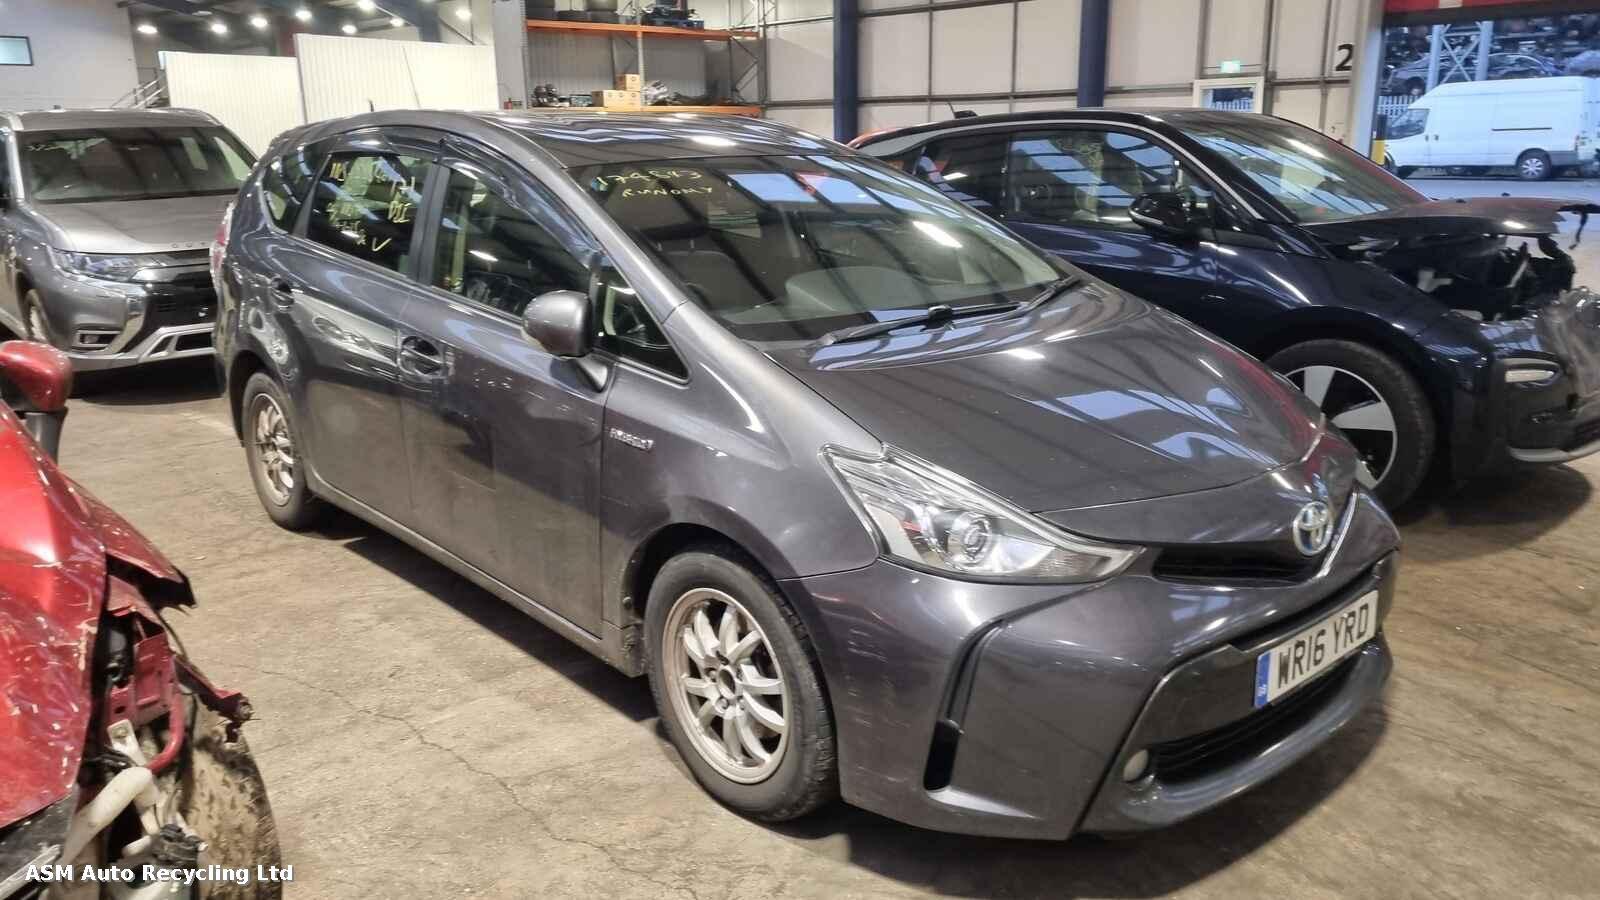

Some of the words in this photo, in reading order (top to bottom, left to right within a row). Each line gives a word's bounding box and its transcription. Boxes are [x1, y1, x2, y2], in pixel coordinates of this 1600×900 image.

[1335, 43, 1354, 71] 2
[1278, 628, 1326, 689] WR16
[1332, 603, 1369, 655] YRD
